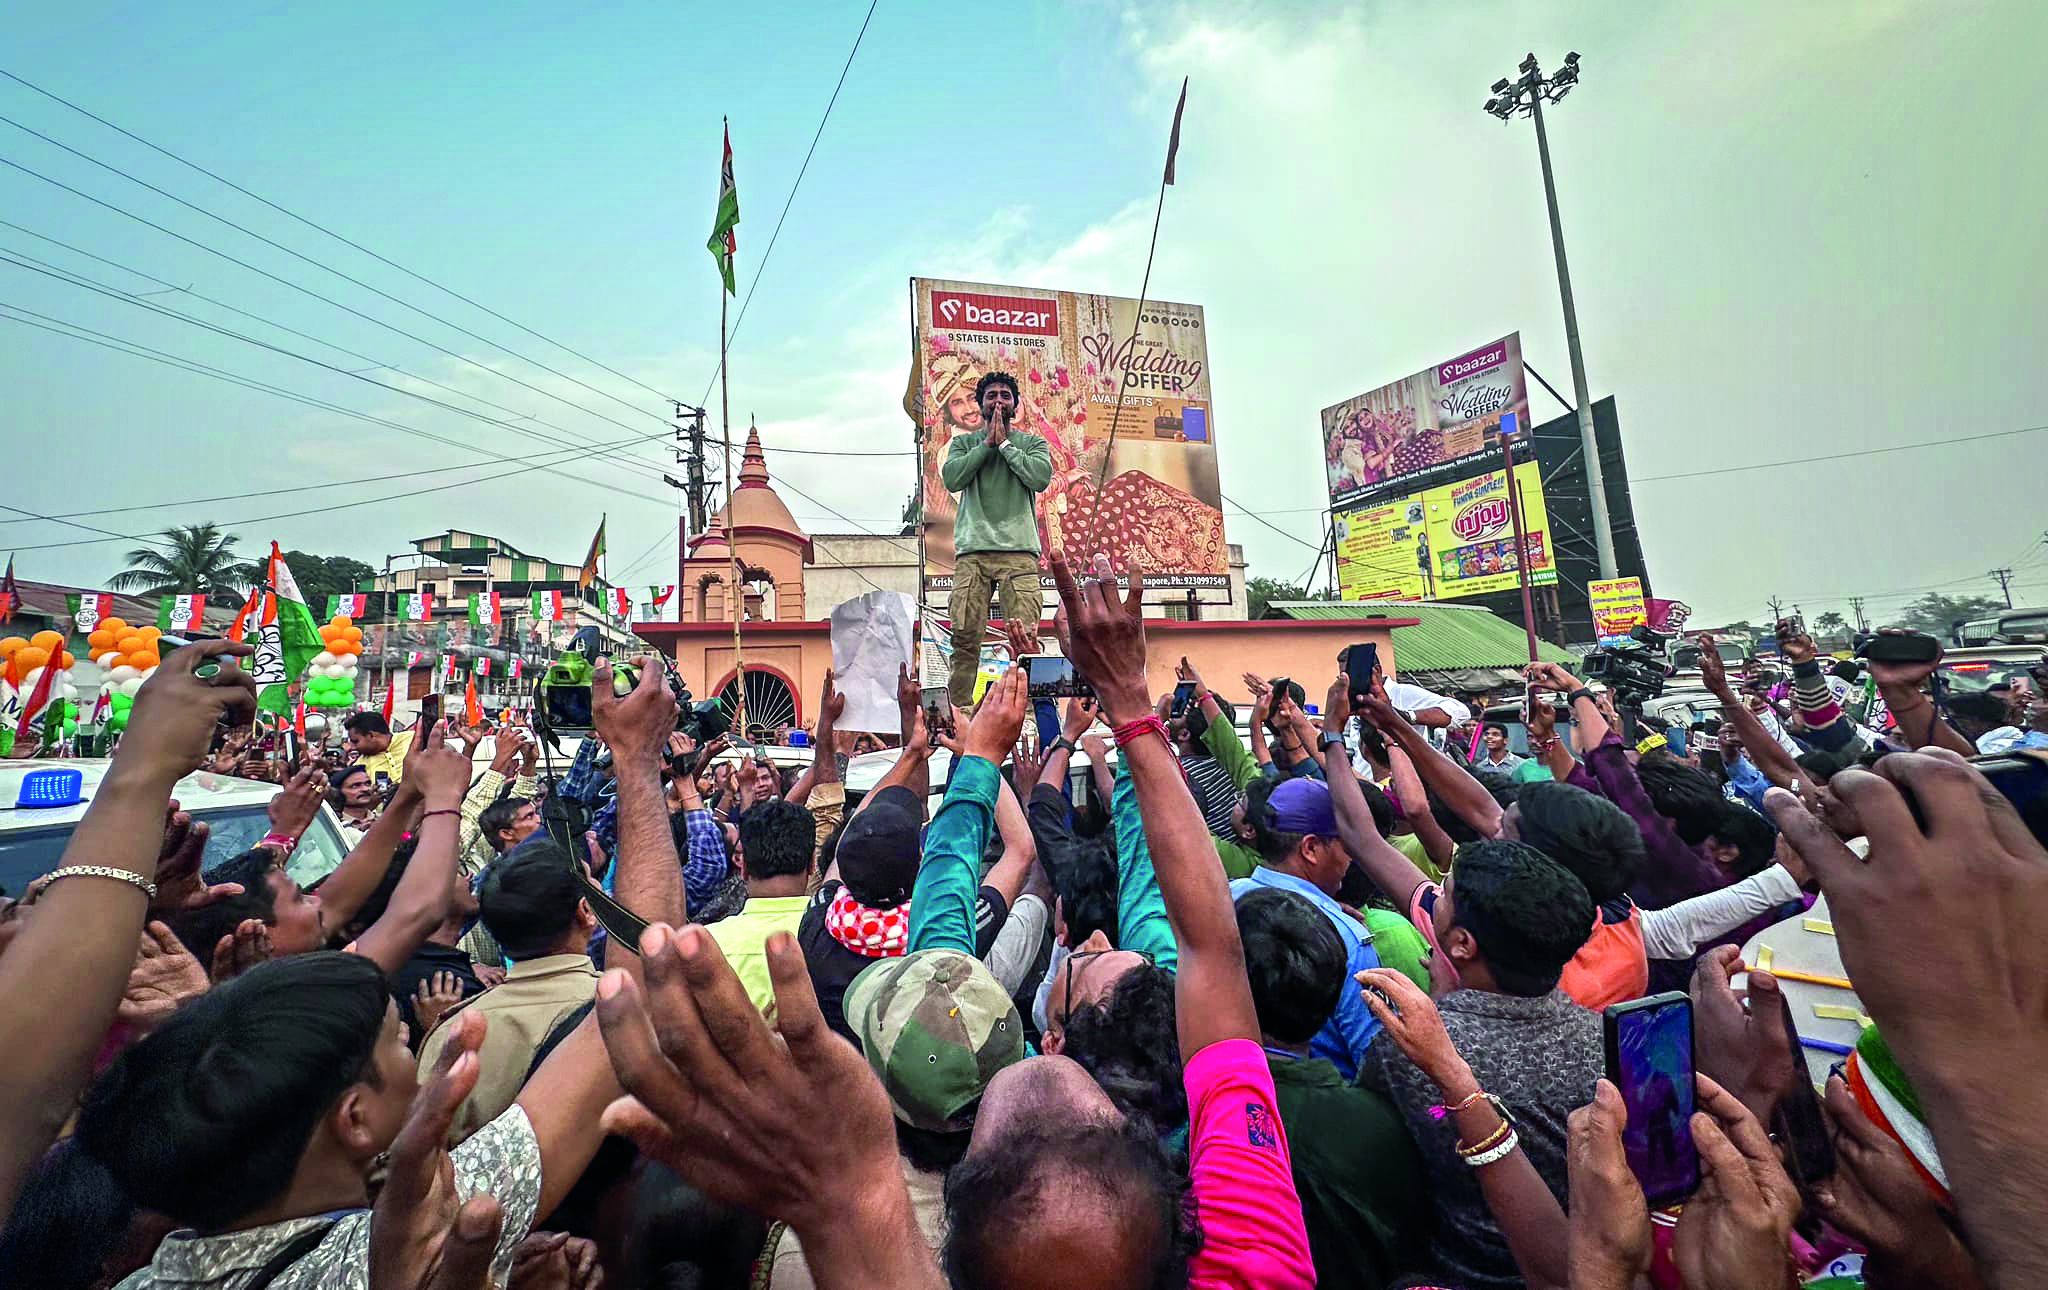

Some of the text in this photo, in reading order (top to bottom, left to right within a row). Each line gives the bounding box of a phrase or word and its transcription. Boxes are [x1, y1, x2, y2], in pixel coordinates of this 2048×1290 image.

[965, 302, 1050, 327] baazar
[948, 333, 954, 341] 9
[956, 334, 989, 344] STATES
[996, 337, 1011, 346] 145
[1013, 338, 1045, 347] STORES
[1081, 332, 1202, 389] Wedding
[1455, 350, 1502, 375] baazar
[1126, 372, 1184, 392] OFFER
[1091, 394, 1153, 407] AVAIL GIFTS
[1441, 385, 1511, 416] Wedding
[1465, 400, 1500, 418] OFFER
